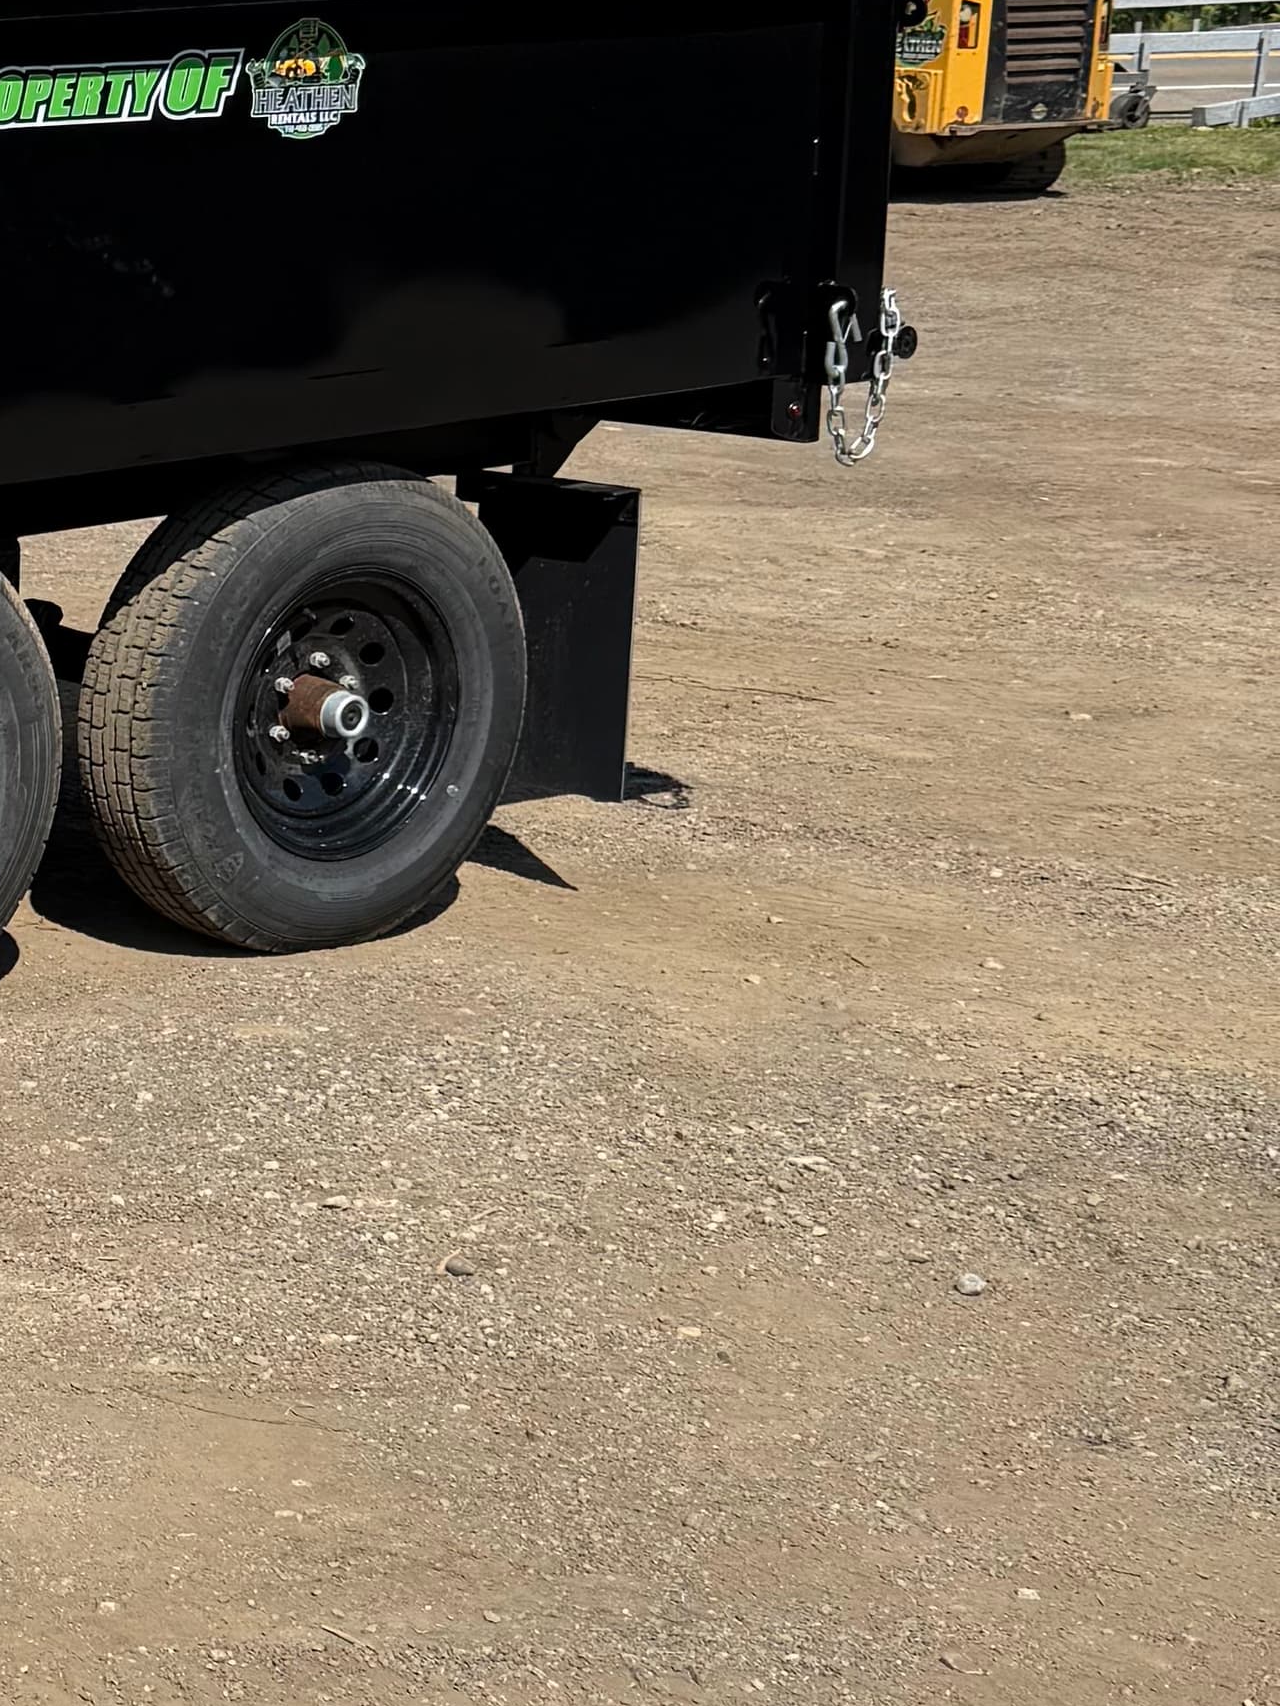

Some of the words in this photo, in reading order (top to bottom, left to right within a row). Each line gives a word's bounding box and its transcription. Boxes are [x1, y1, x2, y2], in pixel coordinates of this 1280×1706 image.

[162, 57, 235, 115] OF
[255, 84, 356, 114] HEATHEN
[271, 112, 318, 125] RENTALS
[319, 110, 338, 122] LLC
